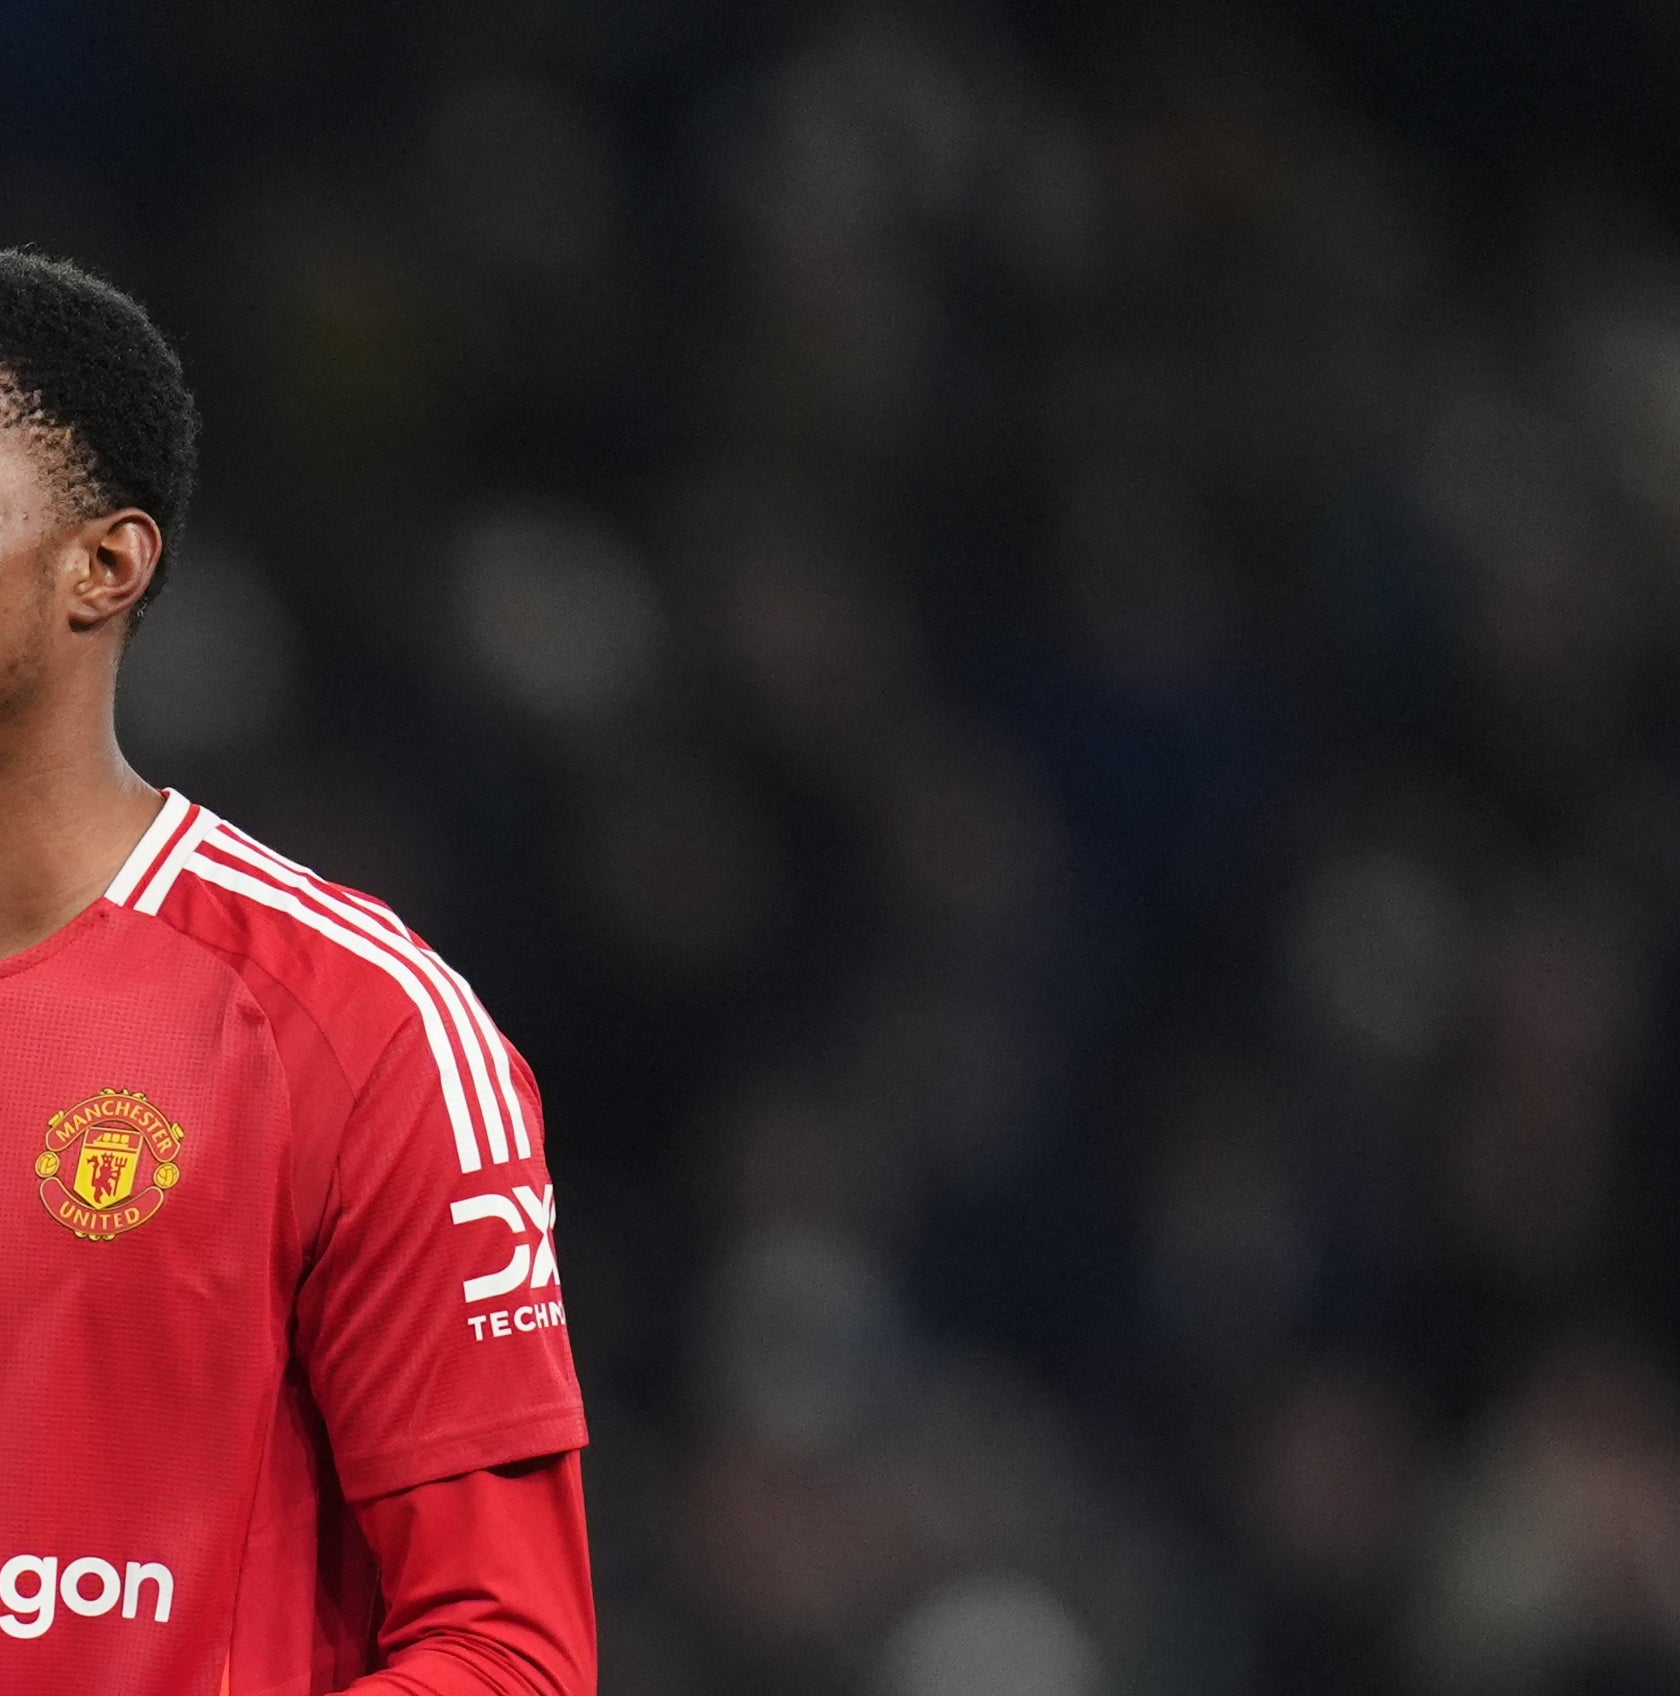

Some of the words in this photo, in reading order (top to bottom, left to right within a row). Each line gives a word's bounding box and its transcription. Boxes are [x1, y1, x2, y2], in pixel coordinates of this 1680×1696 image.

[55, 1100, 173, 1154] MANCHESTER
[58, 1200, 141, 1230] UNITED
[467, 1300, 567, 1342] TECHN
